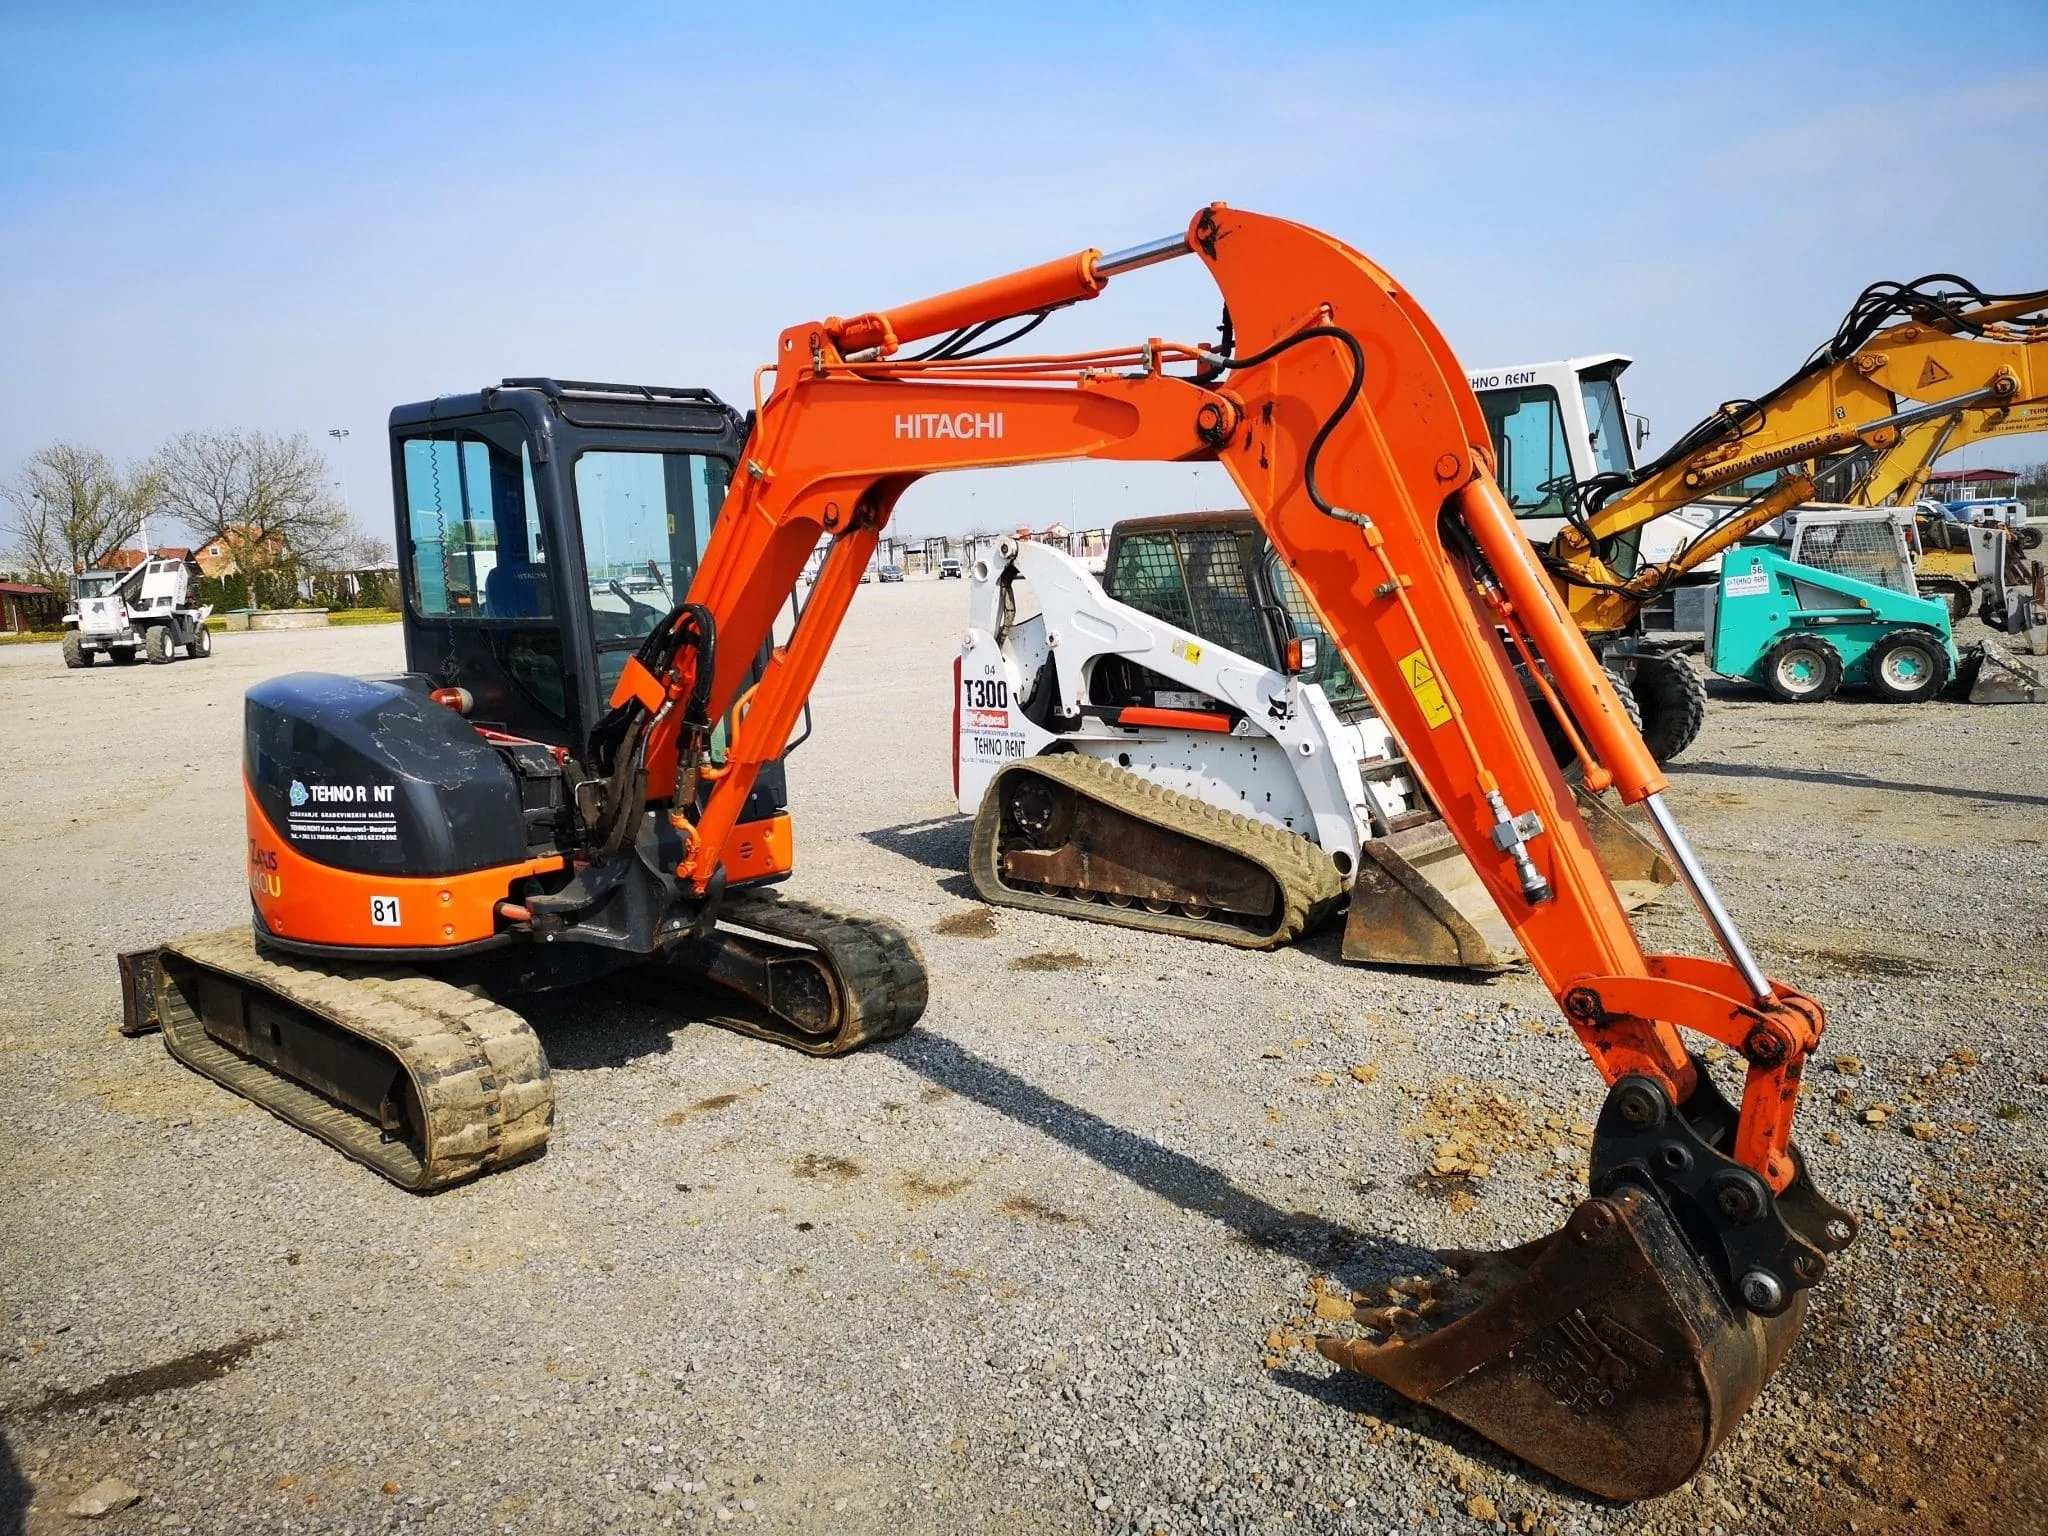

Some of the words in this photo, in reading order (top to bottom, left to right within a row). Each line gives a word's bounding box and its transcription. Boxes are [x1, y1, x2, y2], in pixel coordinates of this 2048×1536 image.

[1469, 376, 1499, 388] HNO
[1505, 372, 1536, 385] RENT
[895, 412, 1004, 439] HITACHI
[1711, 431, 1842, 478] www.tehnorent.rs
[1733, 577, 1751, 585] TEHNO
[1752, 566, 1763, 575] 56
[985, 665, 996, 675] 04
[964, 680, 1008, 709] T300
[974, 737, 1002, 756] TEHNO
[1004, 740, 1026, 758] RENT
[310, 785, 354, 802] TEHNO
[250, 838, 278, 871] ZAXIS
[373, 900, 397, 923] 81
